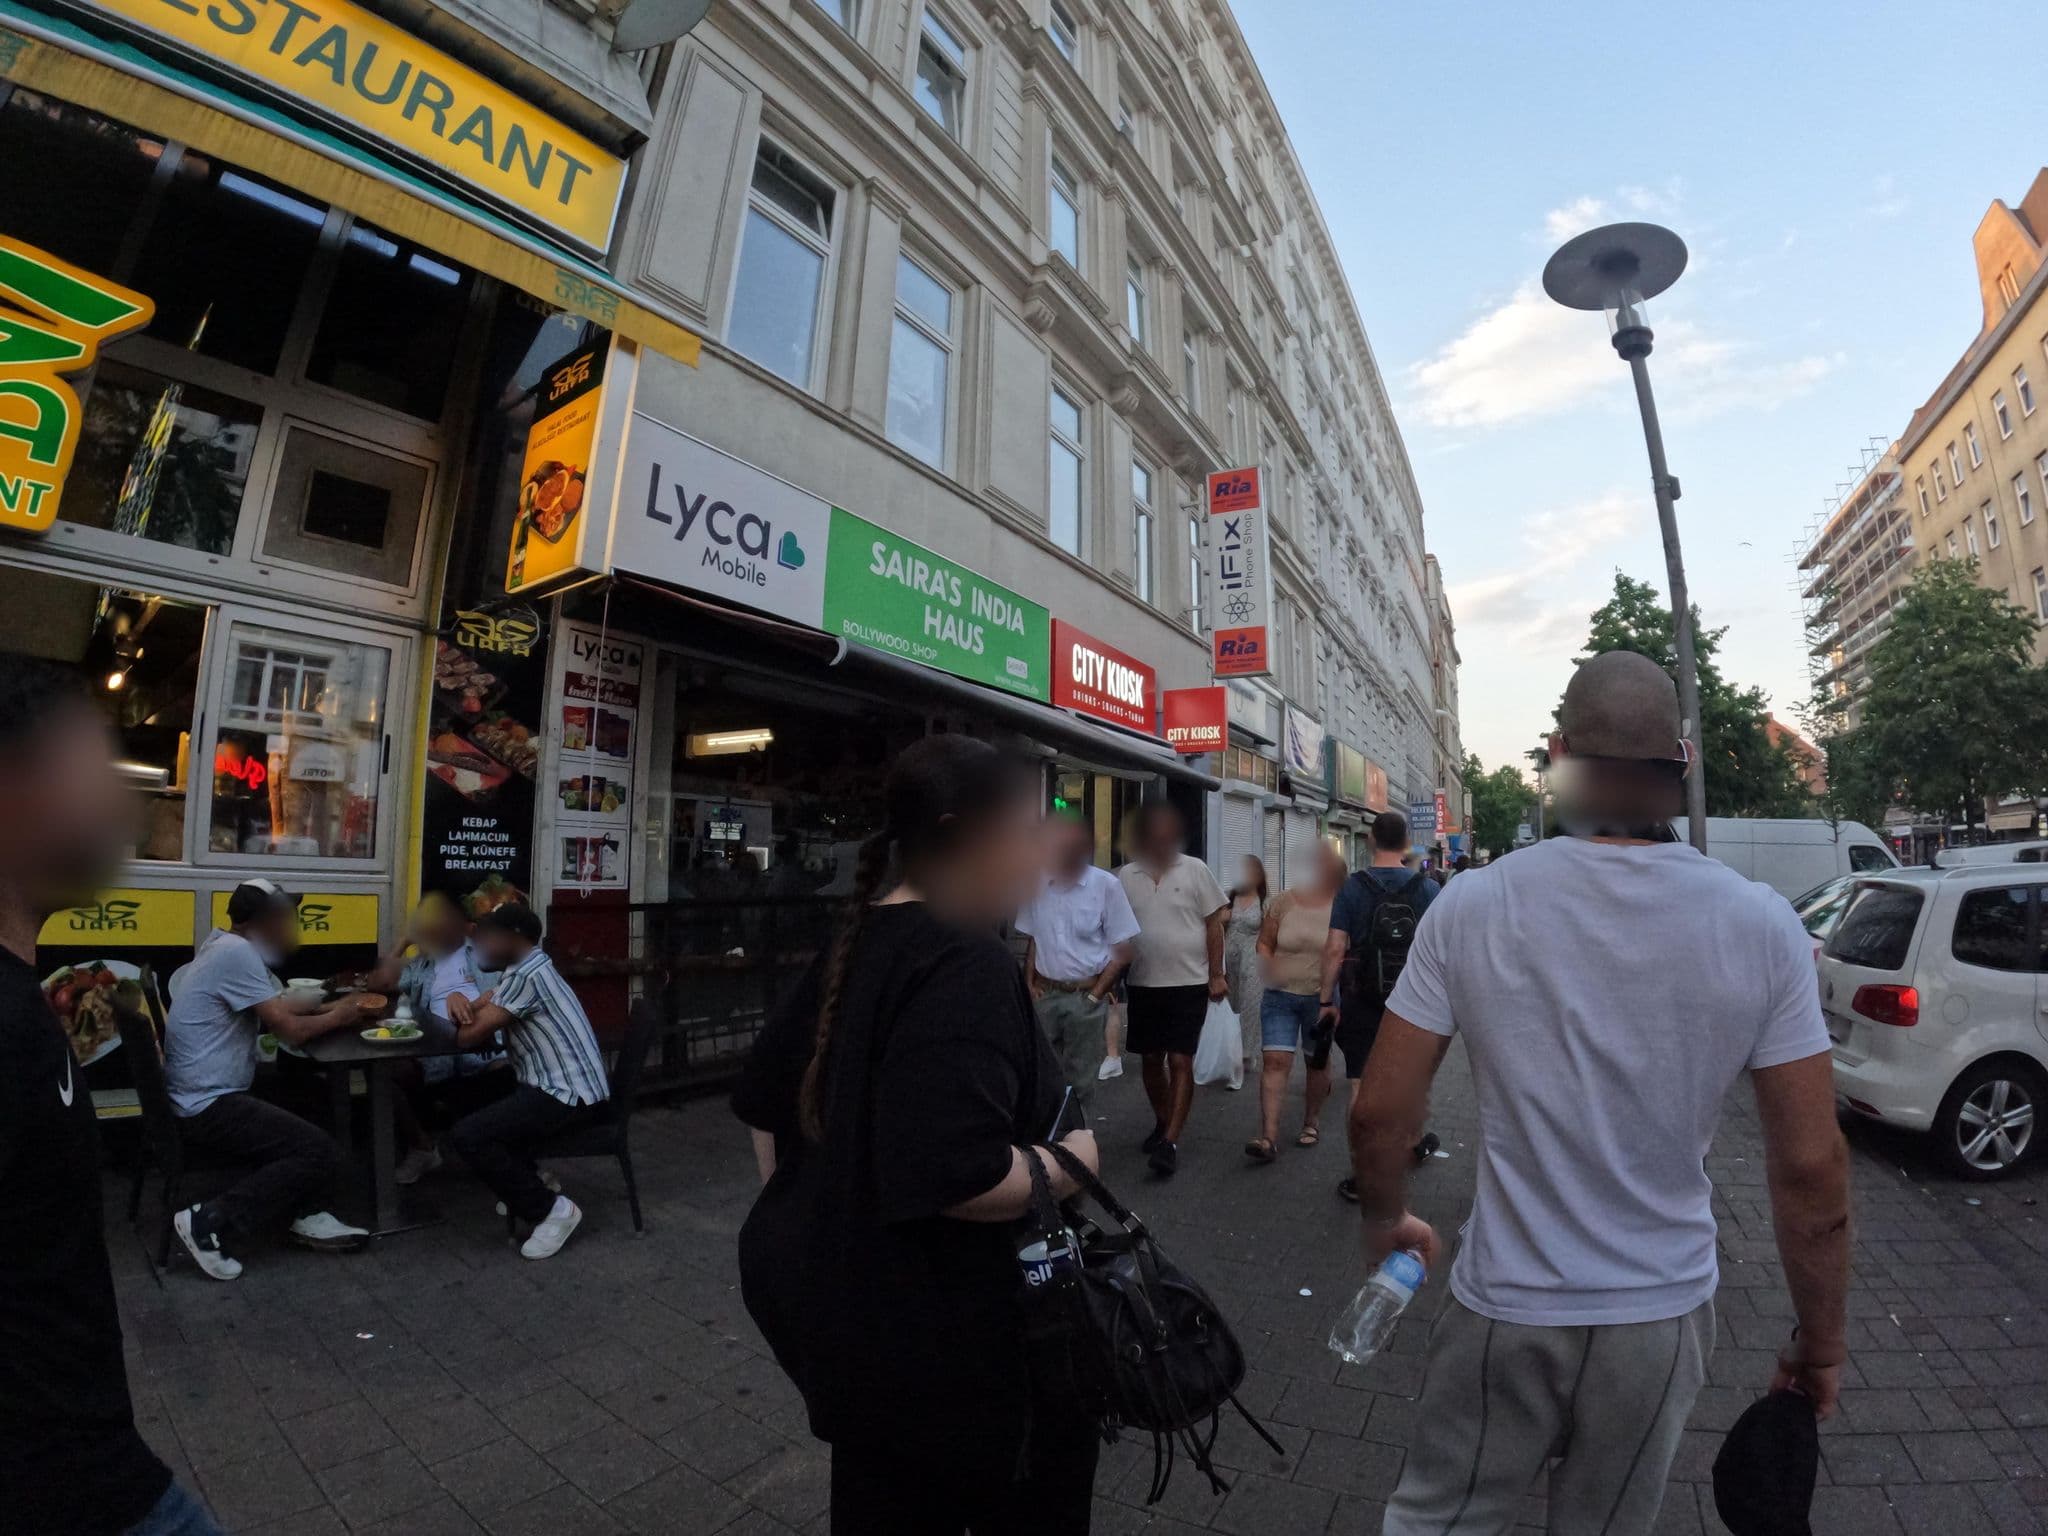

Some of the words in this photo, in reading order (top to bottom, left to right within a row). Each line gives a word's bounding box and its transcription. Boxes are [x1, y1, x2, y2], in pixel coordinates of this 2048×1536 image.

[161, 0, 592, 205] STAURANT
[1216, 476, 1251, 497] Ria
[646, 462, 771, 561] Lyca
[1243, 513, 1254, 545] Shop
[701, 546, 766, 587] Mobile
[1219, 516, 1242, 590] iFix
[1245, 548, 1255, 588] Phone
[869, 541, 962, 608] SAIRA'S
[971, 587, 1025, 636] INDIA
[843, 619, 910, 653] BOLLYWOOD
[912, 642, 938, 660] SHOP
[924, 604, 984, 655] HAUS
[1220, 634, 1258, 656] Ria
[574, 634, 625, 664] Lyca
[1072, 643, 1105, 692] CITY
[1107, 659, 1144, 709] KIOSK
[1167, 727, 1189, 741] CITY
[1191, 725, 1221, 740] KIOSK
[448, 831, 509, 842] LAHMACUN
[462, 817, 497, 828] KEBAP
[439, 845, 469, 857] PIDE,
[445, 859, 511, 870] BREAKFAST
